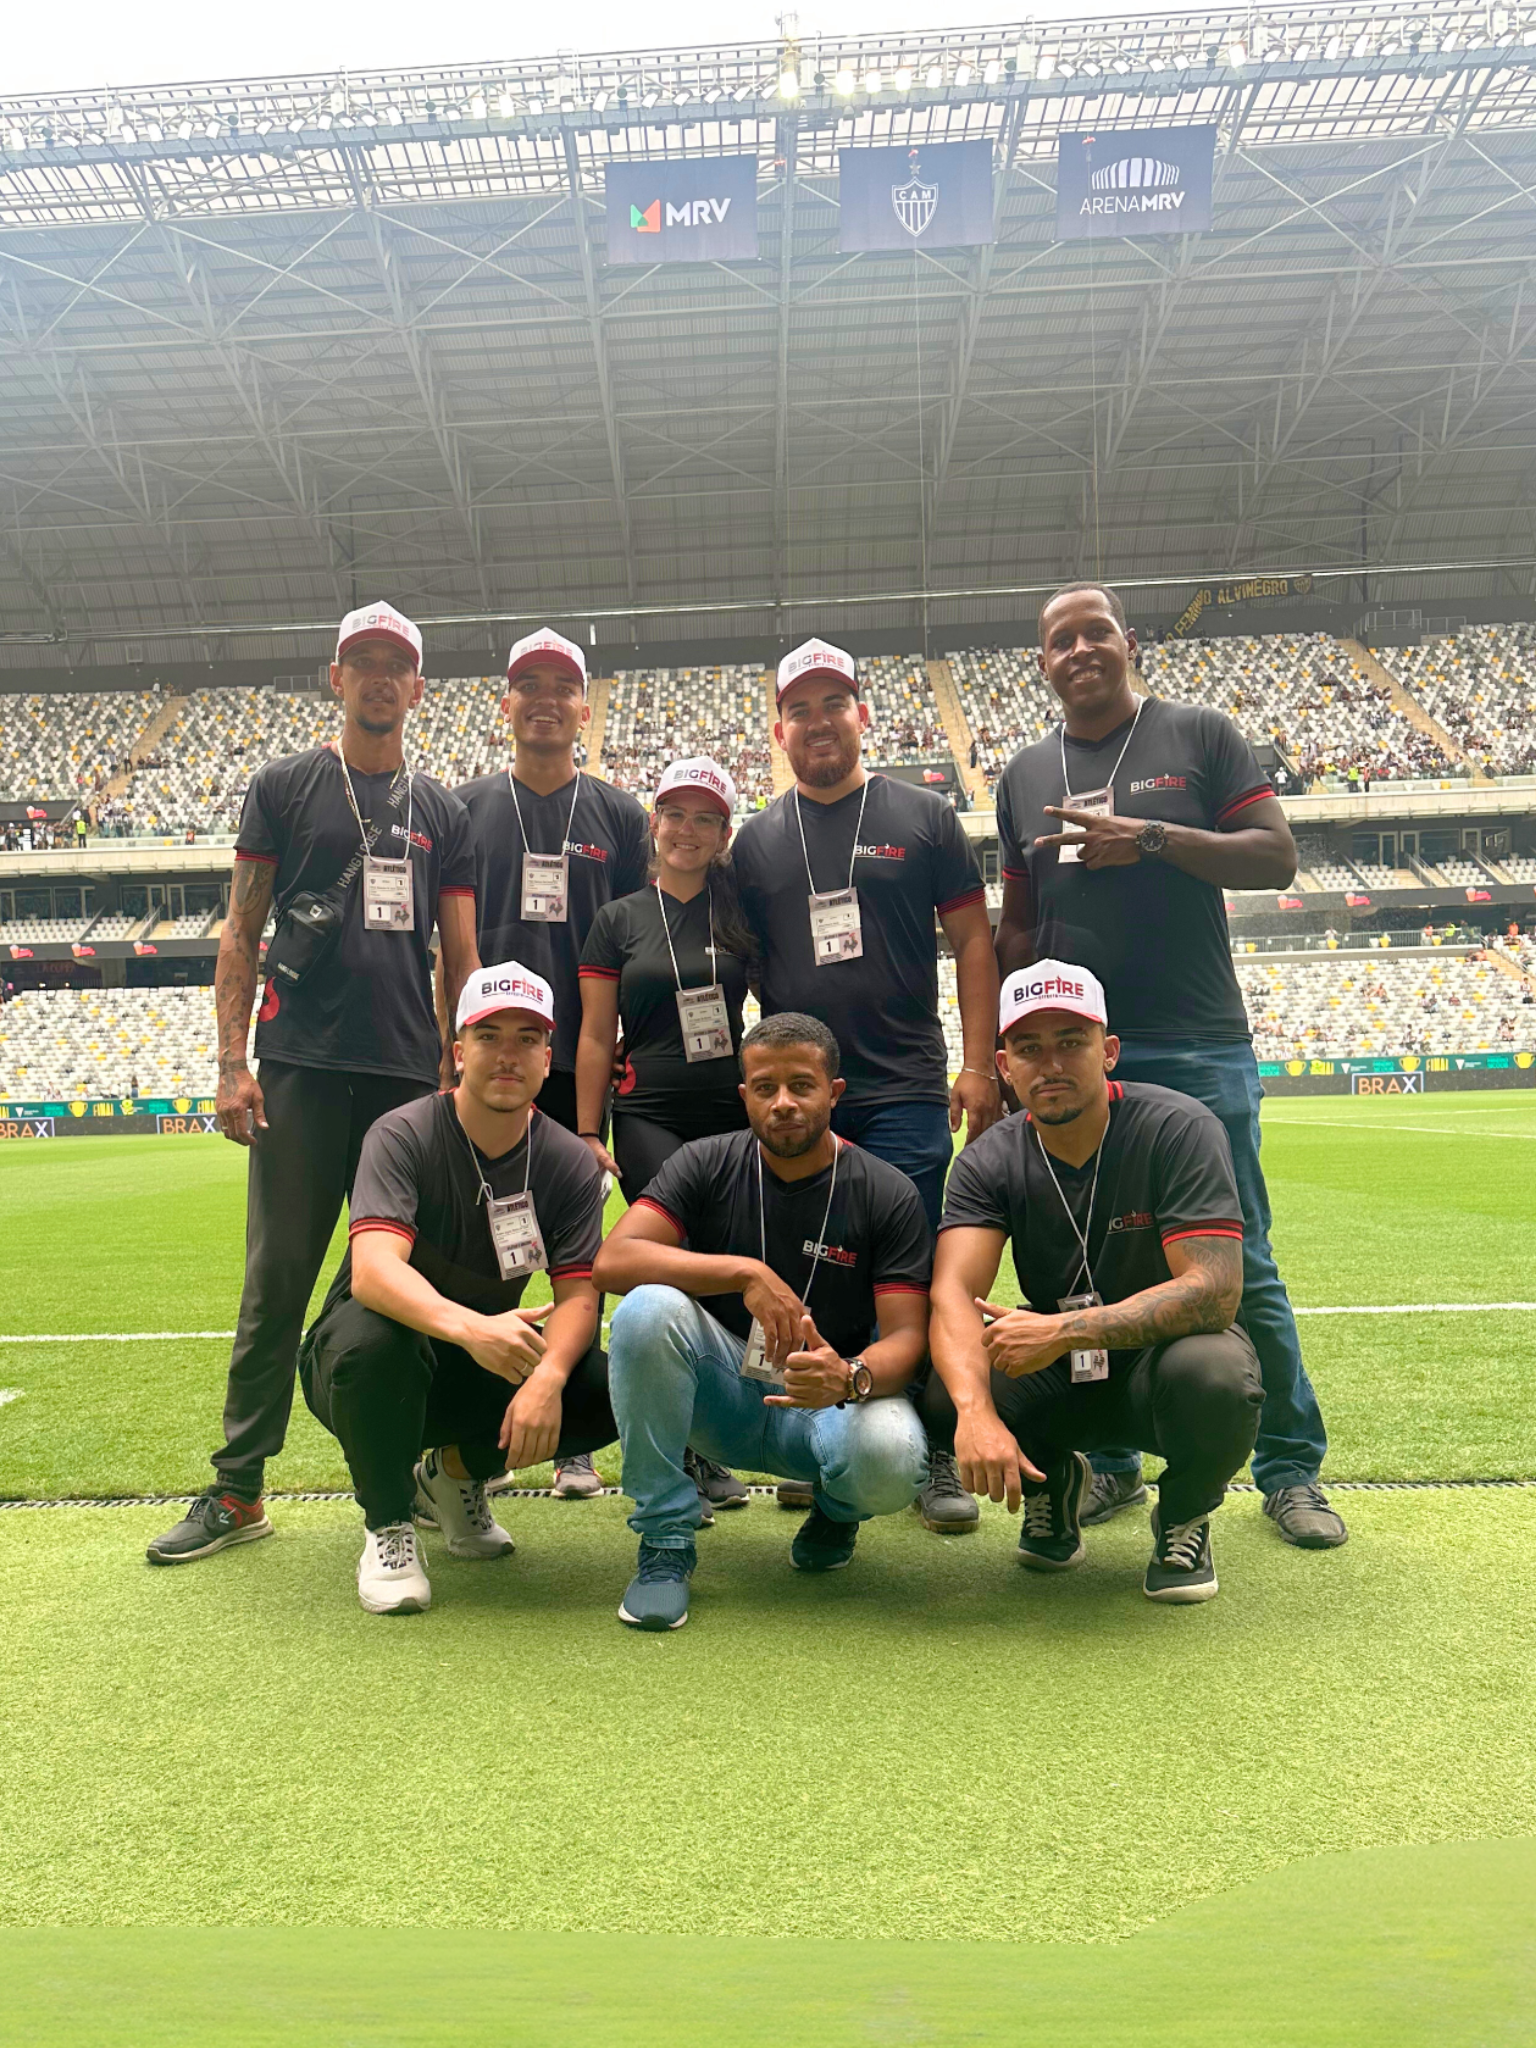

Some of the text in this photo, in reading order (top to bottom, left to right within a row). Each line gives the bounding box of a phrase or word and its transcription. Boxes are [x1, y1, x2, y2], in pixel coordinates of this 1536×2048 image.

[898, 189, 932, 201] CAM
[665, 197, 732, 227] MRV
[1217, 578, 1288, 605] ALVINEGRO
[352, 613, 410, 637] BIGFIRE
[788, 650, 845, 673] BIGFIRE
[673, 768, 727, 795] BIGFIRE
[1130, 773, 1187, 792] BIGFIRE
[562, 840, 608, 860] BIGFIRE
[854, 843, 906, 859] BIGFIRE
[337, 857, 362, 888] HANG
[376, 906, 382, 918] 1
[532, 899, 538, 911] 1
[826, 941, 832, 953] 1
[481, 977, 544, 1002] BIGFIRE
[1013, 975, 1084, 1003] BIGFIRE
[696, 1038, 703, 1050] 1
[1358, 1076, 1418, 1095] BRAX
[163, 1116, 217, 1135] BRAX
[1108, 1209, 1153, 1230] IGFIRE
[510, 1251, 517, 1265] 1
[802, 1239, 858, 1265] BIGFIRE
[758, 1353, 765, 1367] 1
[1080, 1354, 1085, 1368] 1
